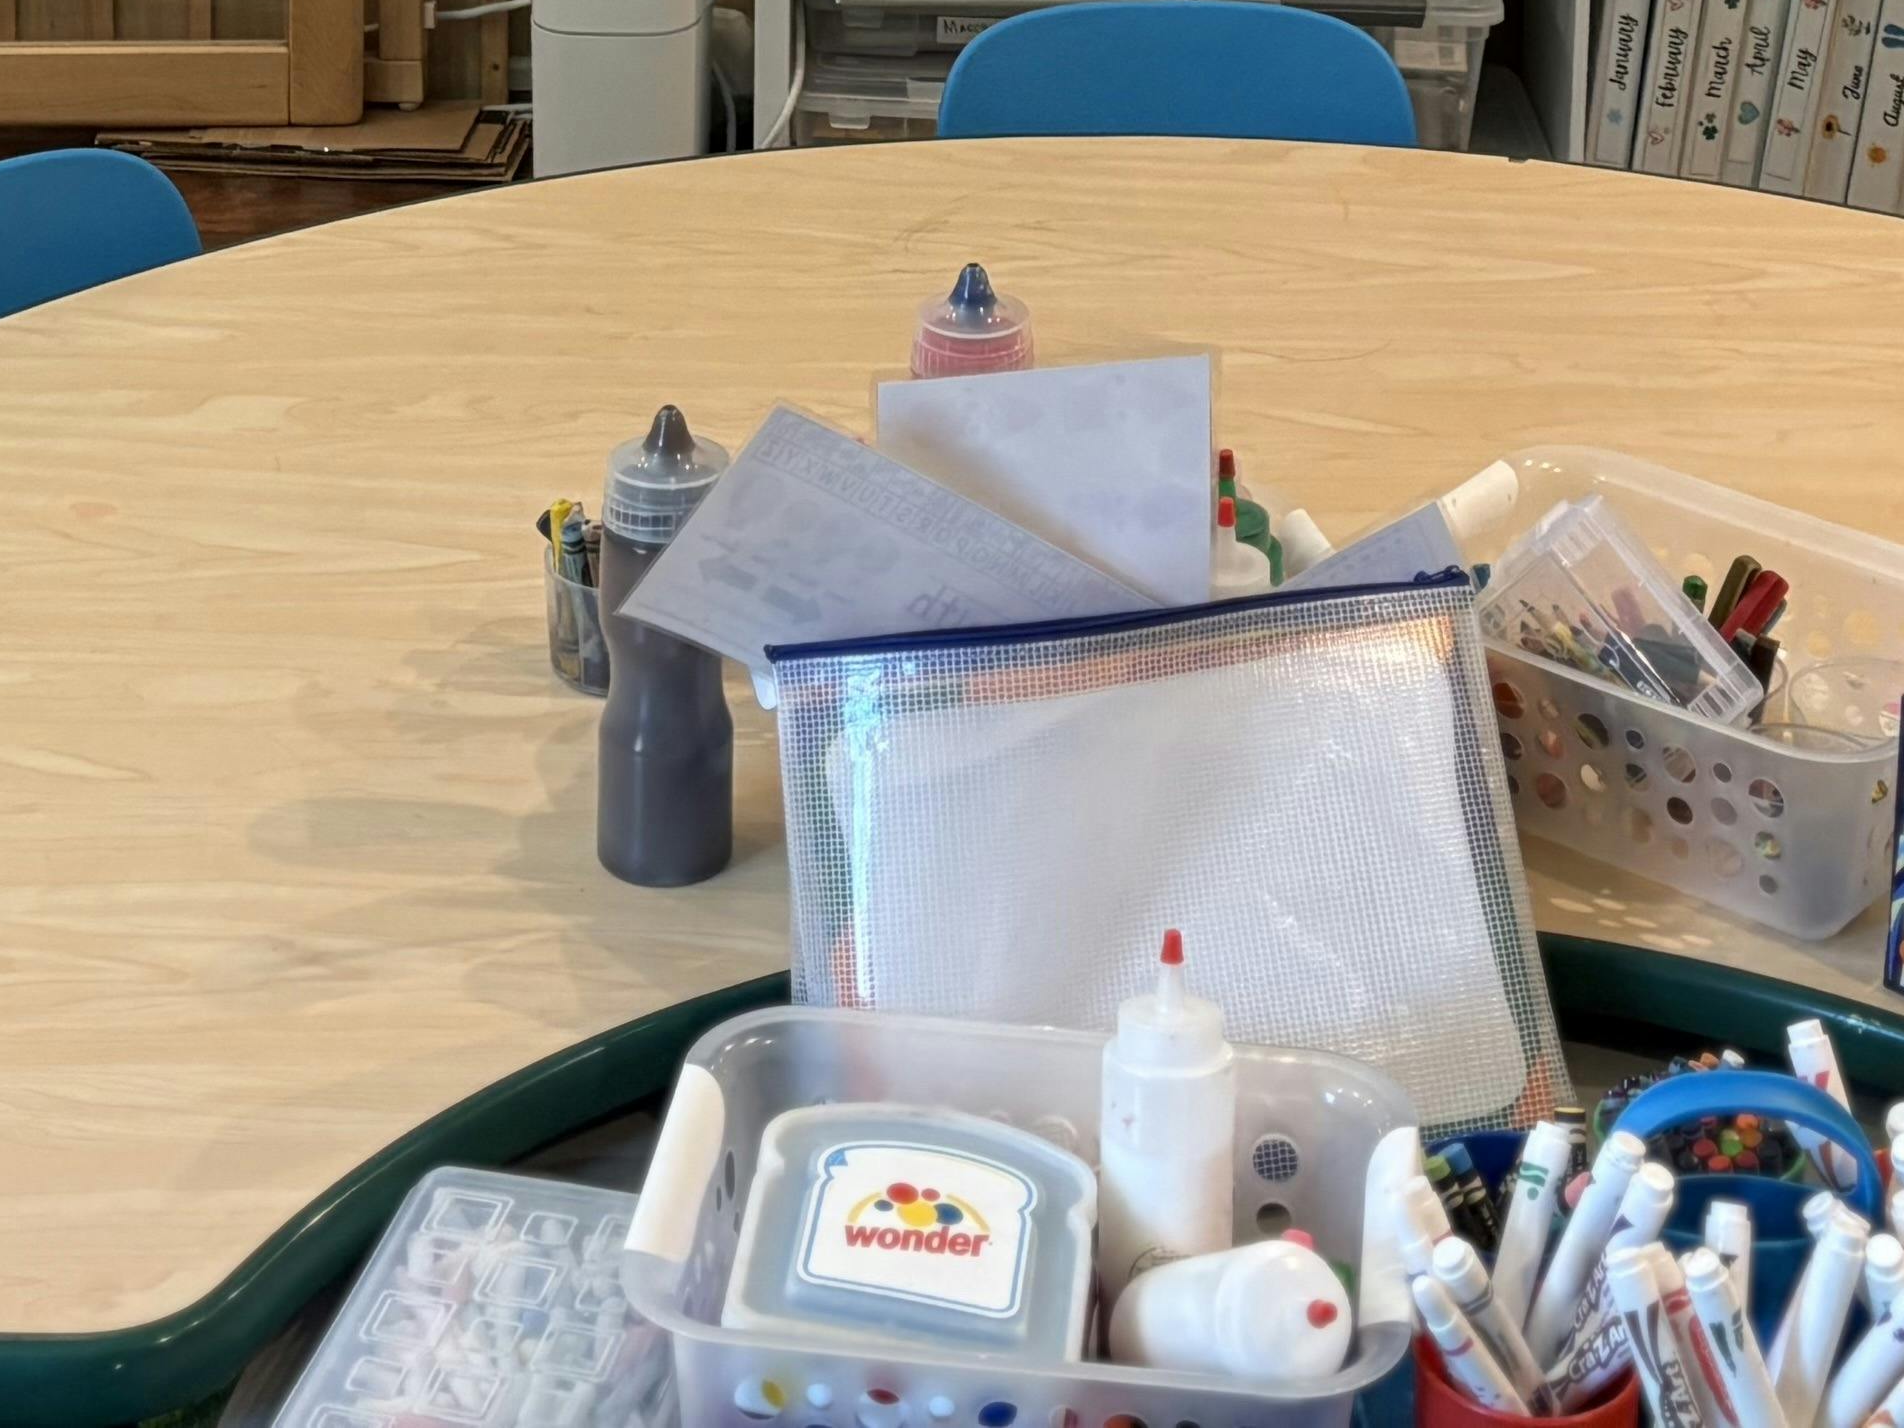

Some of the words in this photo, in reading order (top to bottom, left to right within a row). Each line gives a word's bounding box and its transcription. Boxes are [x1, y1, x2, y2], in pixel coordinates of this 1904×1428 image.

[1616, 13, 1640, 92] January
[1655, 26, 1688, 109] February
[1705, 36, 1733, 100] March
[1748, 25, 1772, 75] April
[1787, 46, 1813, 91] May
[1842, 64, 1864, 101] June
[845, 1225, 989, 1257] wonder
